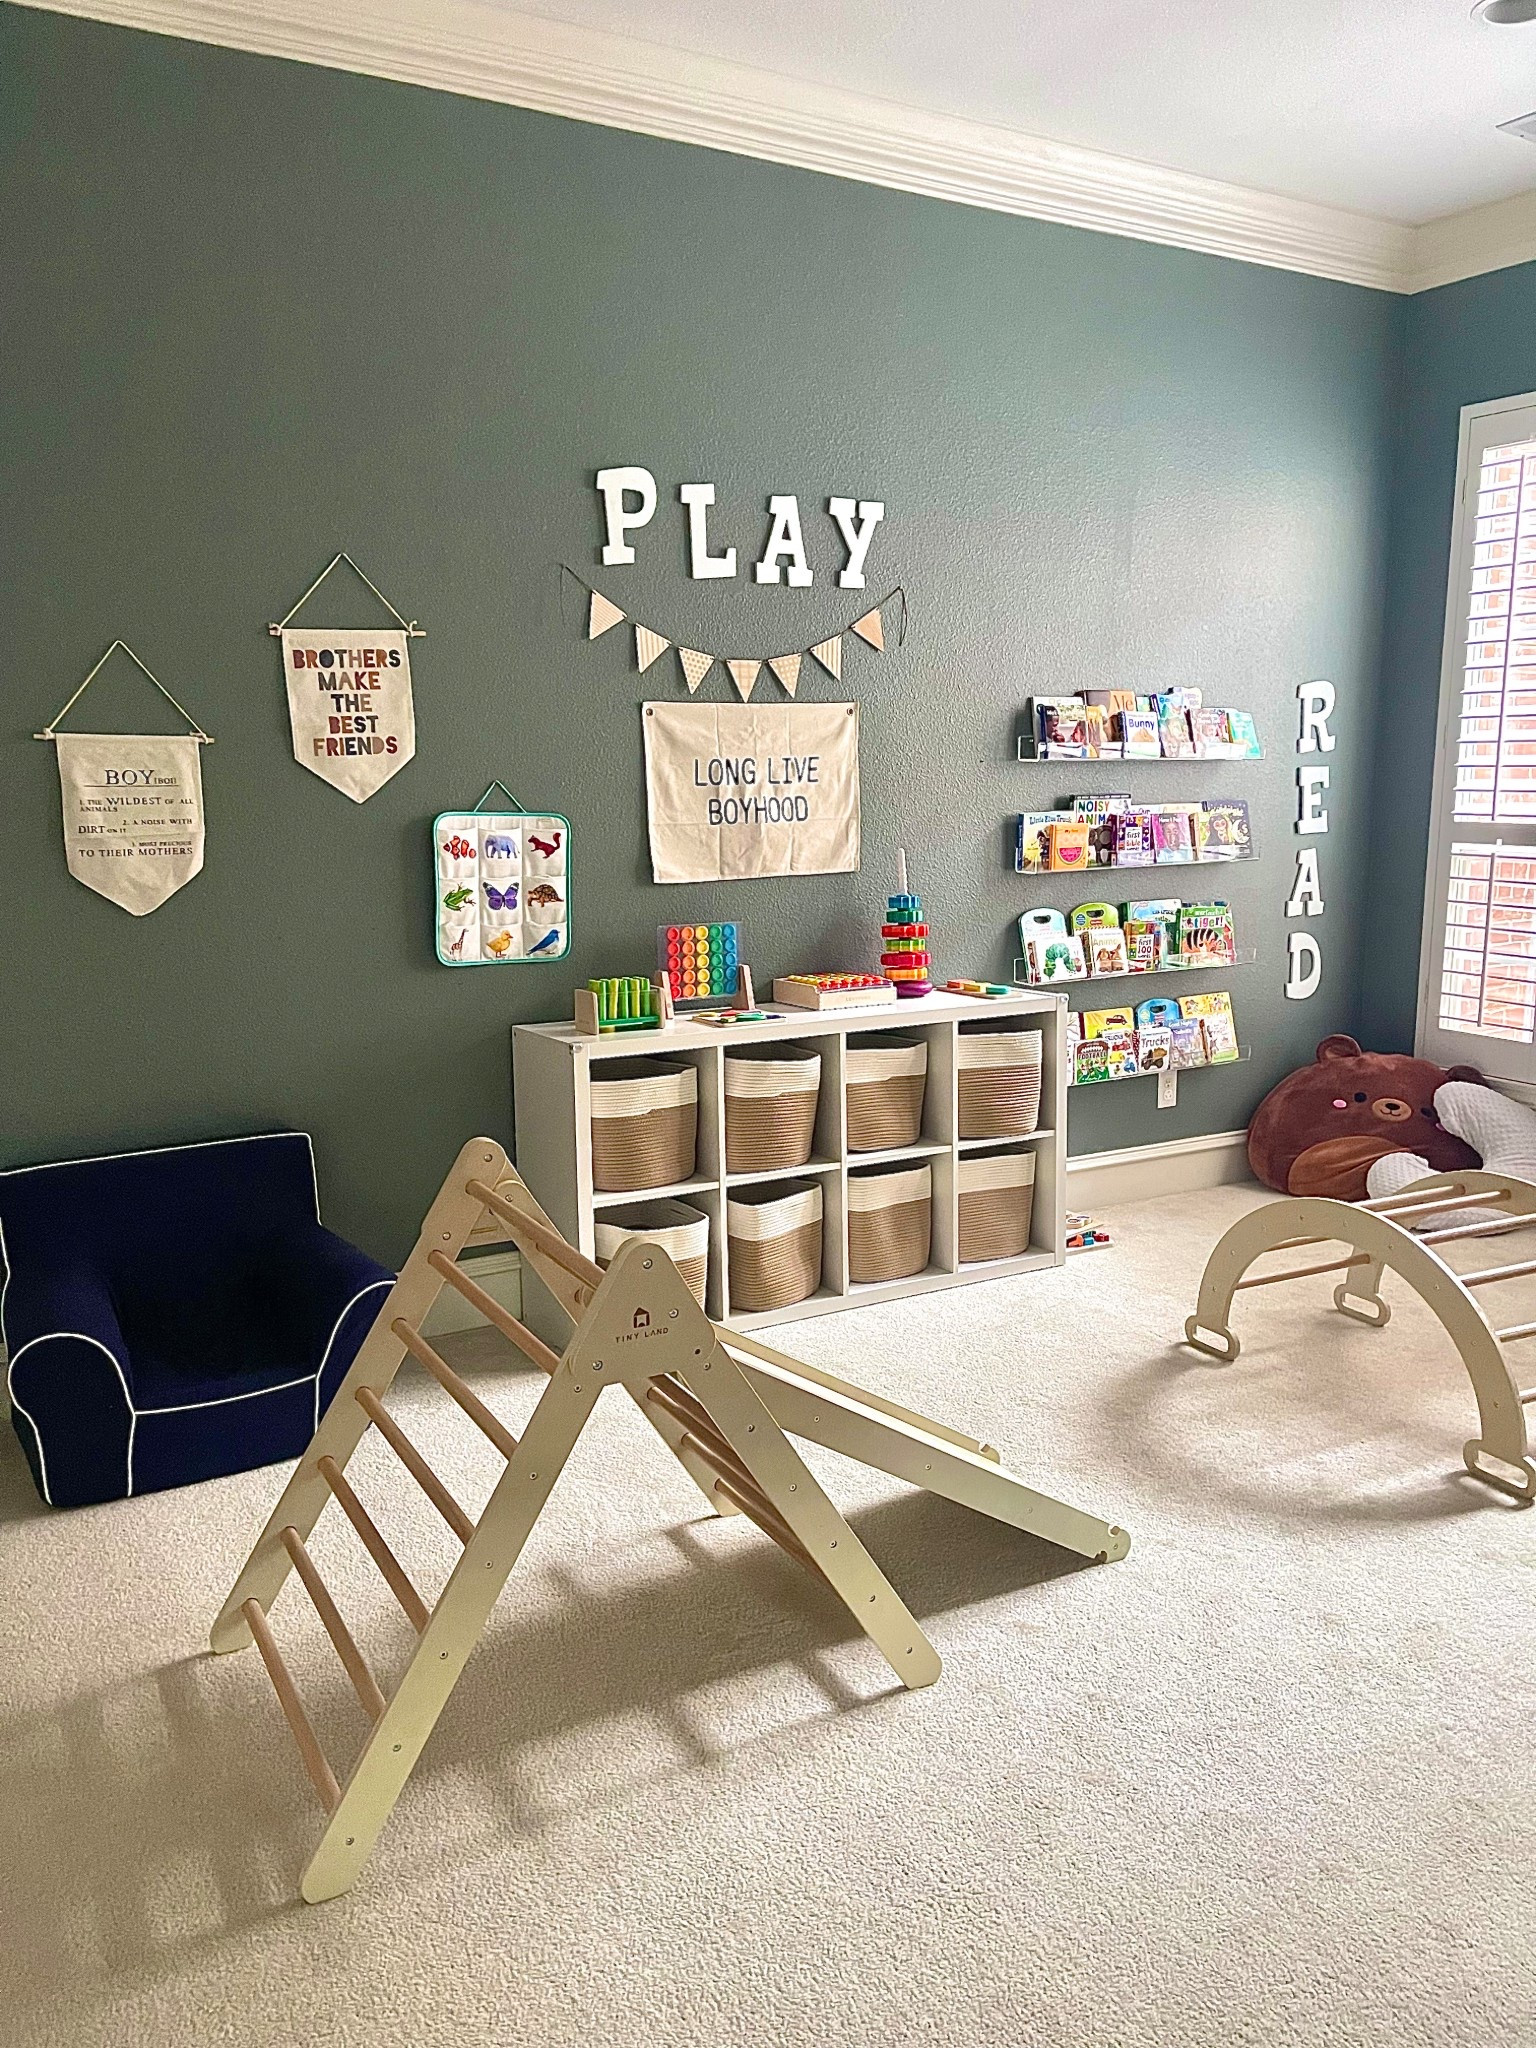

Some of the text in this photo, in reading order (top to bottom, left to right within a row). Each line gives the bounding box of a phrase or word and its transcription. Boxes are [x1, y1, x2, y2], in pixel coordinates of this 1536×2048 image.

[597, 466, 885, 589] PLAY
[293, 649, 400, 669] BROTHERS
[318, 671, 381, 691] MAKE
[331, 693, 373, 713] THE
[328, 715, 379, 734] BEST
[1129, 718, 1155, 731] Bunny
[313, 736, 398, 757] FRIENDS
[105, 769, 155, 785] BOY
[695, 756, 820, 787] LONG LIVE
[105, 797, 162, 806] WILDEST
[1078, 801, 1109, 813] NOISY
[708, 795, 809, 826] BOYHOOD
[78, 825, 105, 834] DIRT
[1284, 680, 1336, 1000] READ
[79, 847, 193, 858] TO THEIR MOTHERS
[1194, 916, 1224, 929] tiger!
[1138, 946, 1152, 954] 100
[1141, 1036, 1170, 1048] Trucks
[615, 1327, 669, 1343] TINY LAND
